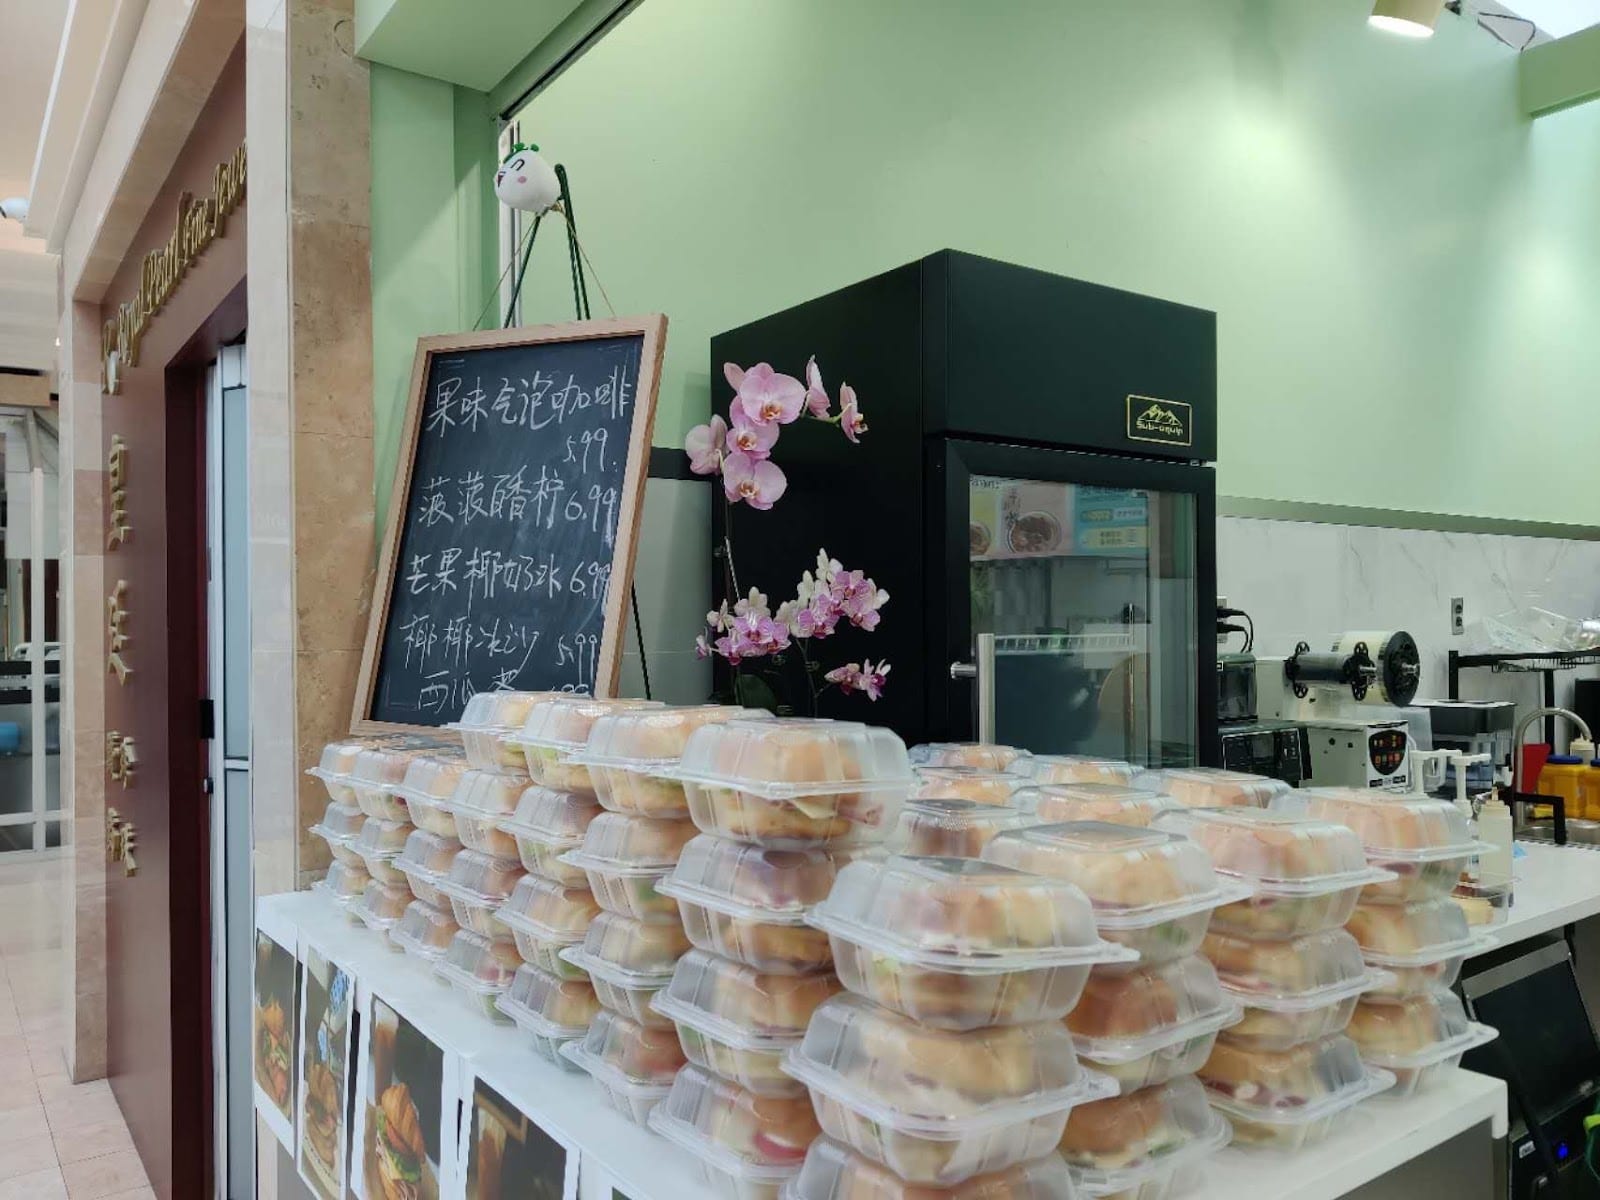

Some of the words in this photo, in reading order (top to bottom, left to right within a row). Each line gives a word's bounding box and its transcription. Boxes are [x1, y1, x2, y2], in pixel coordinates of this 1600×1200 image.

[426, 365, 632, 438] 果味气泡咖啡
